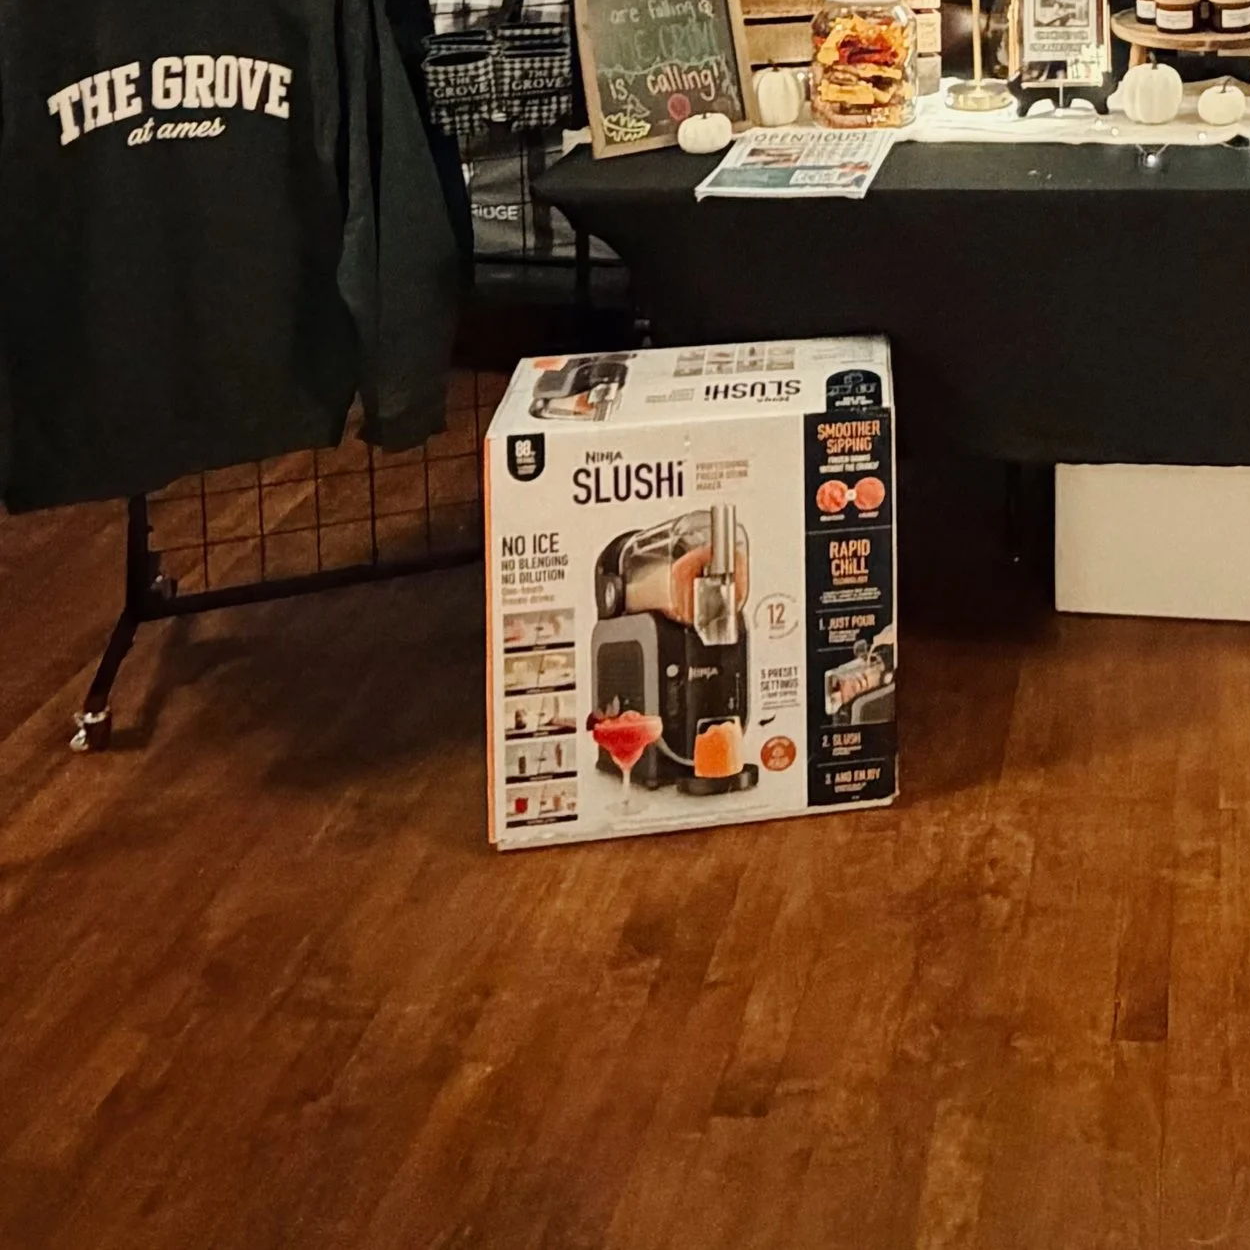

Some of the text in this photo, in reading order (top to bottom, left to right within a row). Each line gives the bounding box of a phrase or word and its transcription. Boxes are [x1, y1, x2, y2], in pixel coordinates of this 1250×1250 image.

[610, 7, 640, 25] are
[433, 82, 490, 98] GROVE
[512, 77, 564, 91] GROVE
[609, 64, 719, 101] is calling!
[47, 55, 293, 146] THE GROVE
[127, 117, 226, 146] at ames
[754, 132, 803, 143] OPEN
[817, 419, 881, 441] SMOOTHER
[572, 460, 684, 505] SLUSHi
[502, 533, 559, 557] NO ICE
[829, 538, 871, 559] RAPID
[501, 555, 568, 572] NO BLENDING
[501, 569, 565, 585] NO DILUTION
[767, 603, 786, 625] 12
[828, 616, 849, 632] JUST
[851, 614, 875, 629] POUR
